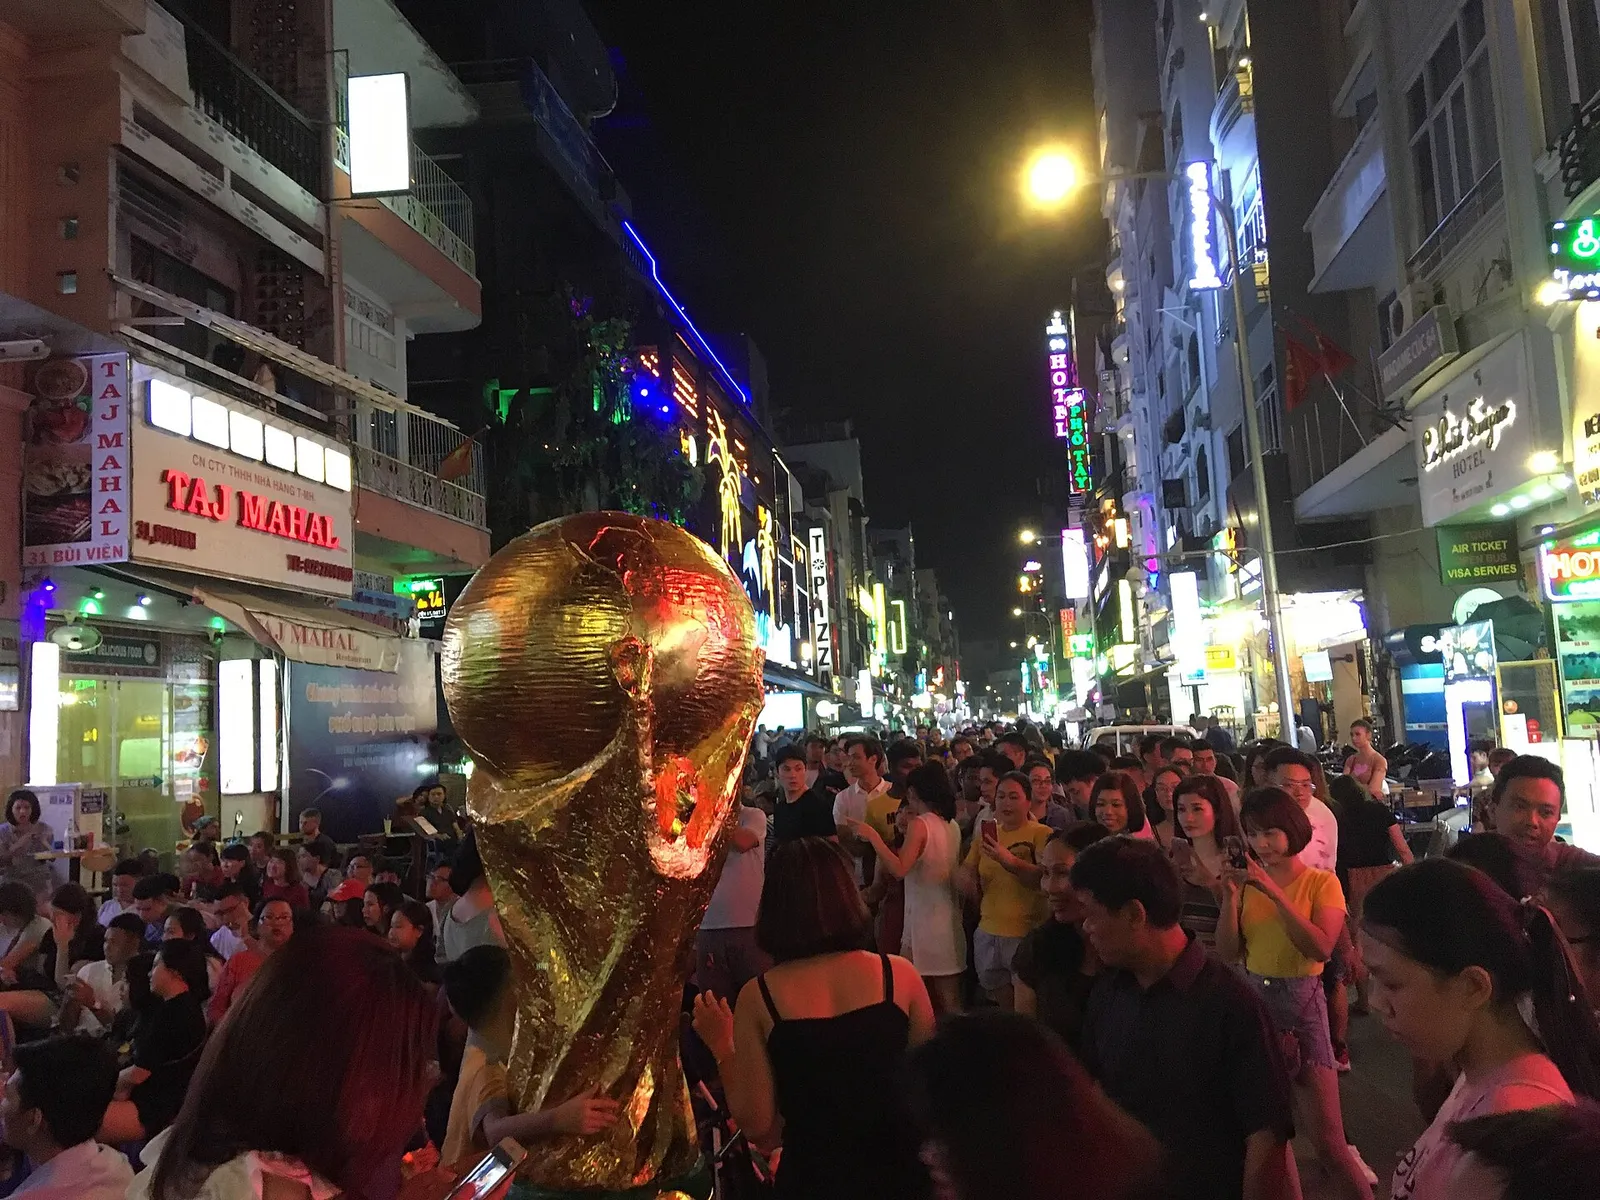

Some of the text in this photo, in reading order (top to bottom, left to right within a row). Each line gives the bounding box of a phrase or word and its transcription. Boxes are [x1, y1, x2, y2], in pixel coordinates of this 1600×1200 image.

[1050, 353, 1067, 437] HOTEL
[97, 361, 124, 537] TAJ MAHAL
[191, 453, 206, 468] CN
[207, 459, 226, 474] CTY
[1452, 449, 1486, 479] HOTEL
[163, 468, 233, 522] TAJ
[237, 491, 340, 550] MAHAL
[28, 551, 46, 565] 31
[53, 546, 80, 563] BÙI
[1451, 540, 1508, 554] AIR TICKET
[1447, 564, 1517, 579] VISA SERVIES
[258, 618, 360, 650] AJ MAHAL
